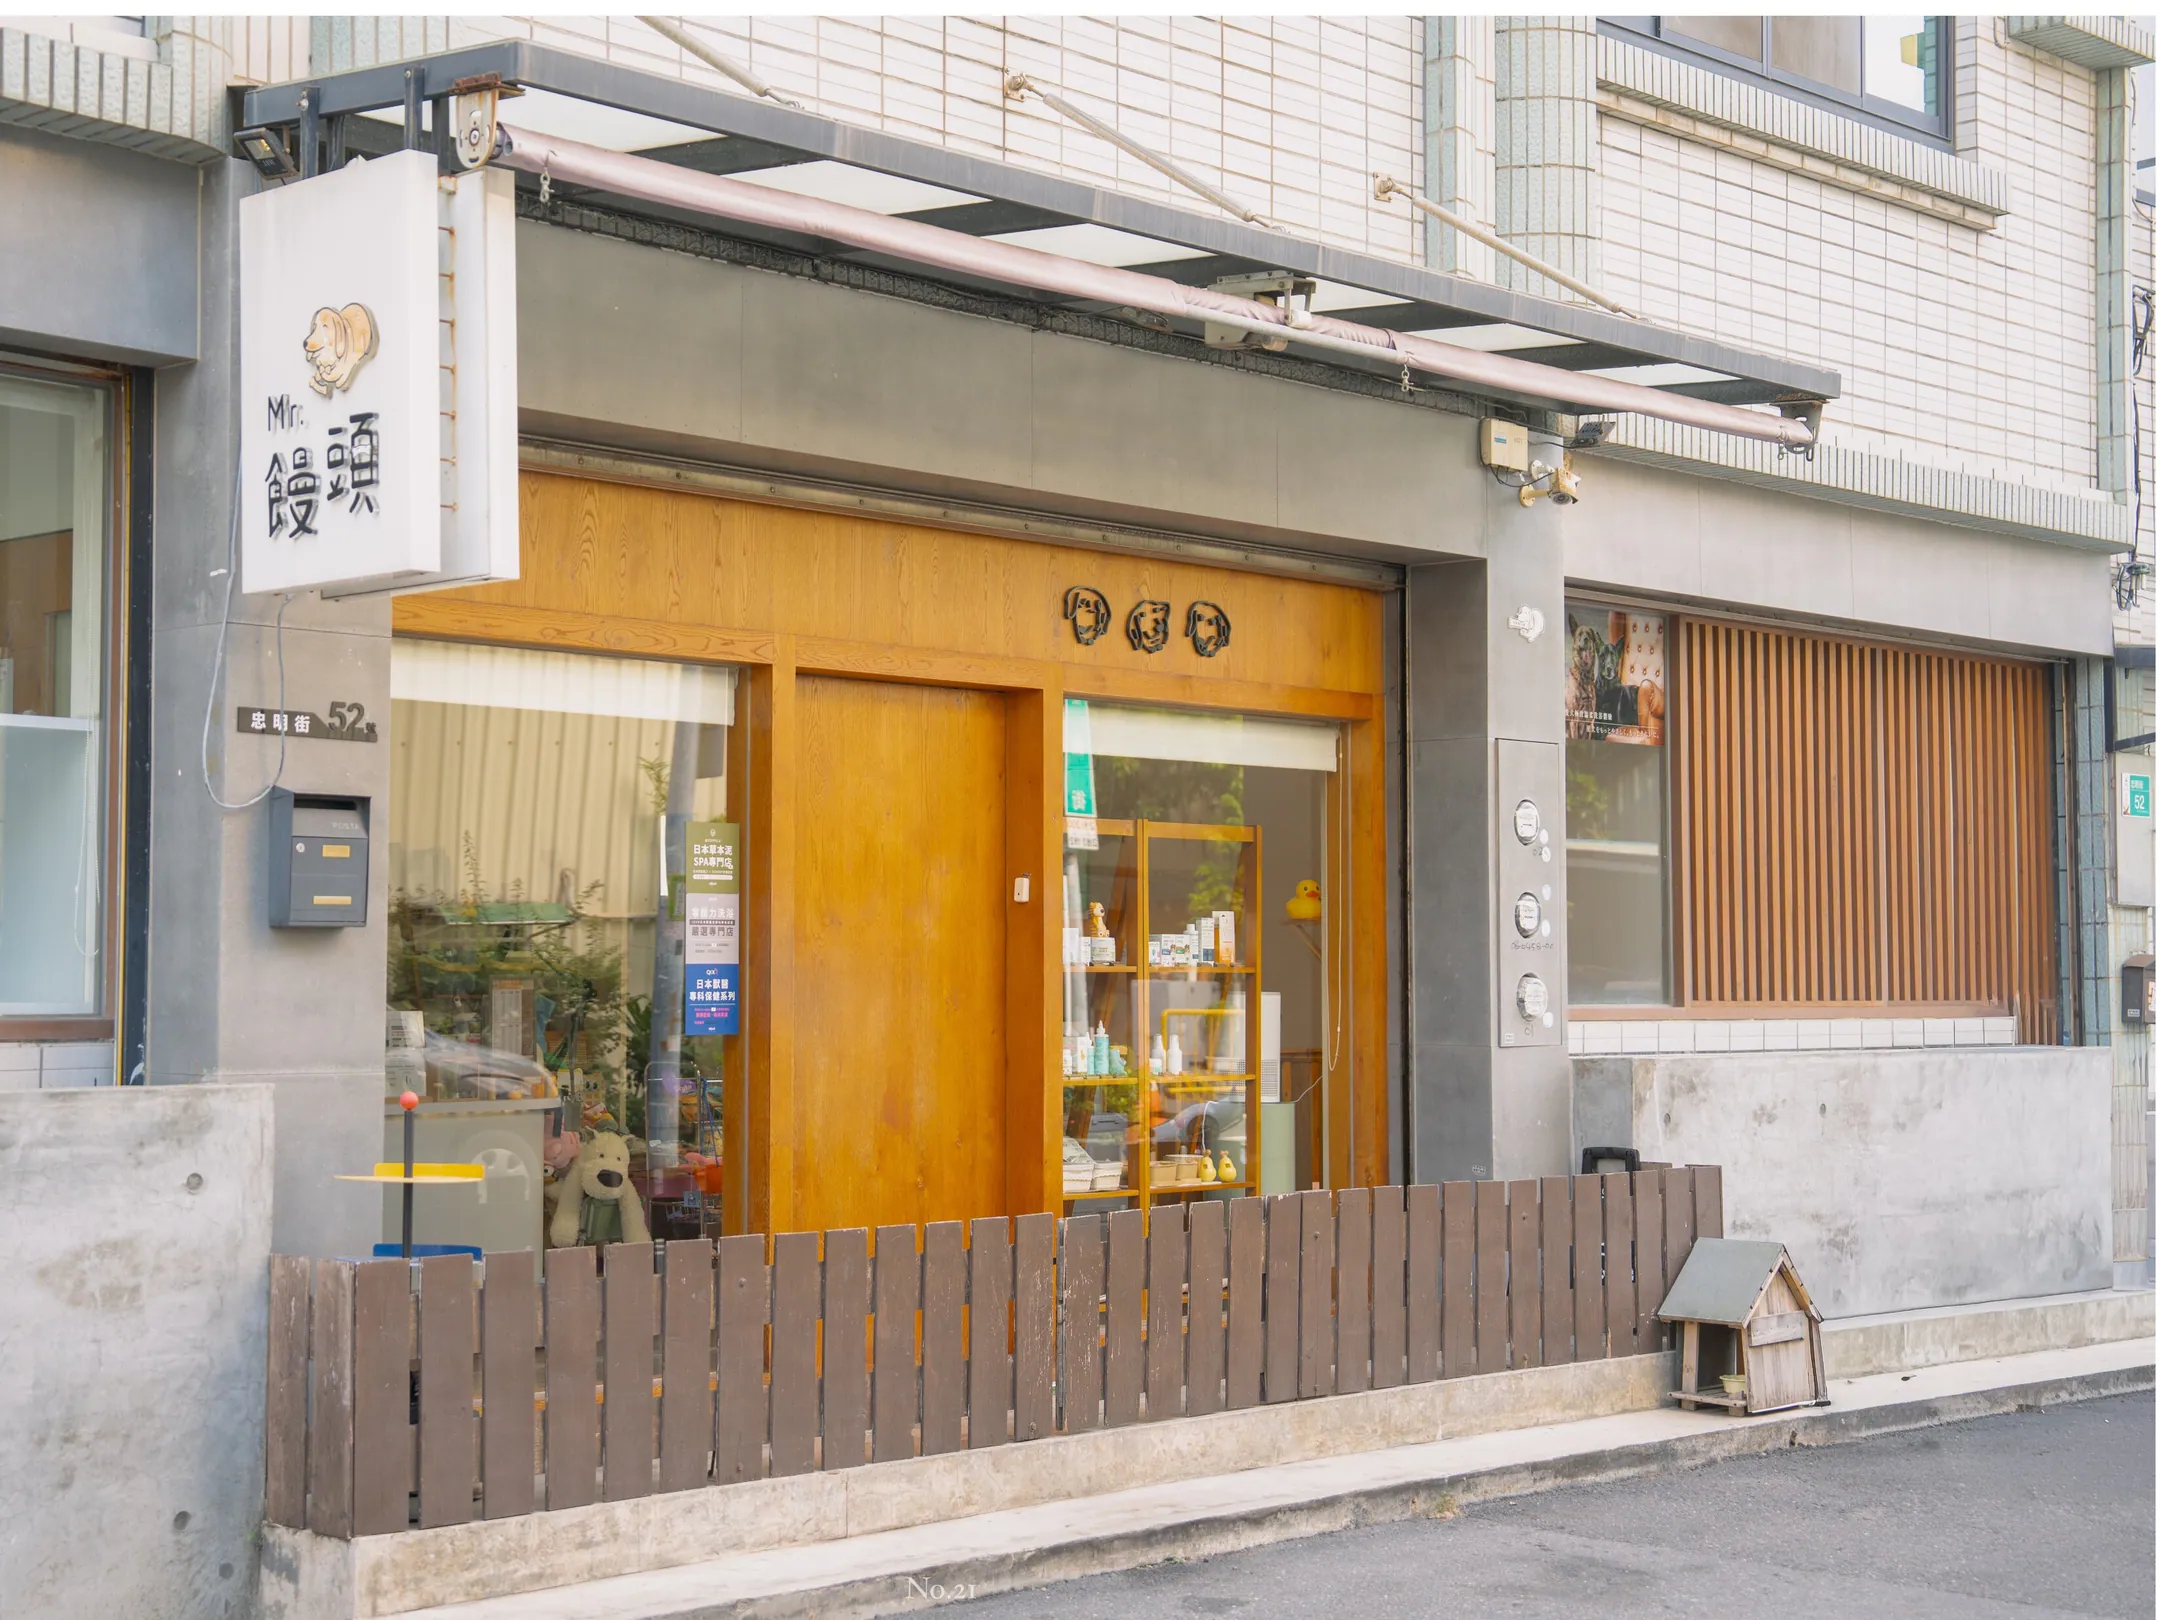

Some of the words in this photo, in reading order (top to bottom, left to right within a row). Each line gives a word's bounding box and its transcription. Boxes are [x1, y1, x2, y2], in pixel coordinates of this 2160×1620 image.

[268, 394, 306, 432] Mr.
[265, 412, 379, 539] 饅頭
[251, 711, 310, 733] 忠明街
[2134, 794, 2145, 810] 52
[693, 844, 733, 855] 日本草本泥
[693, 857, 734, 868] SPA專門店
